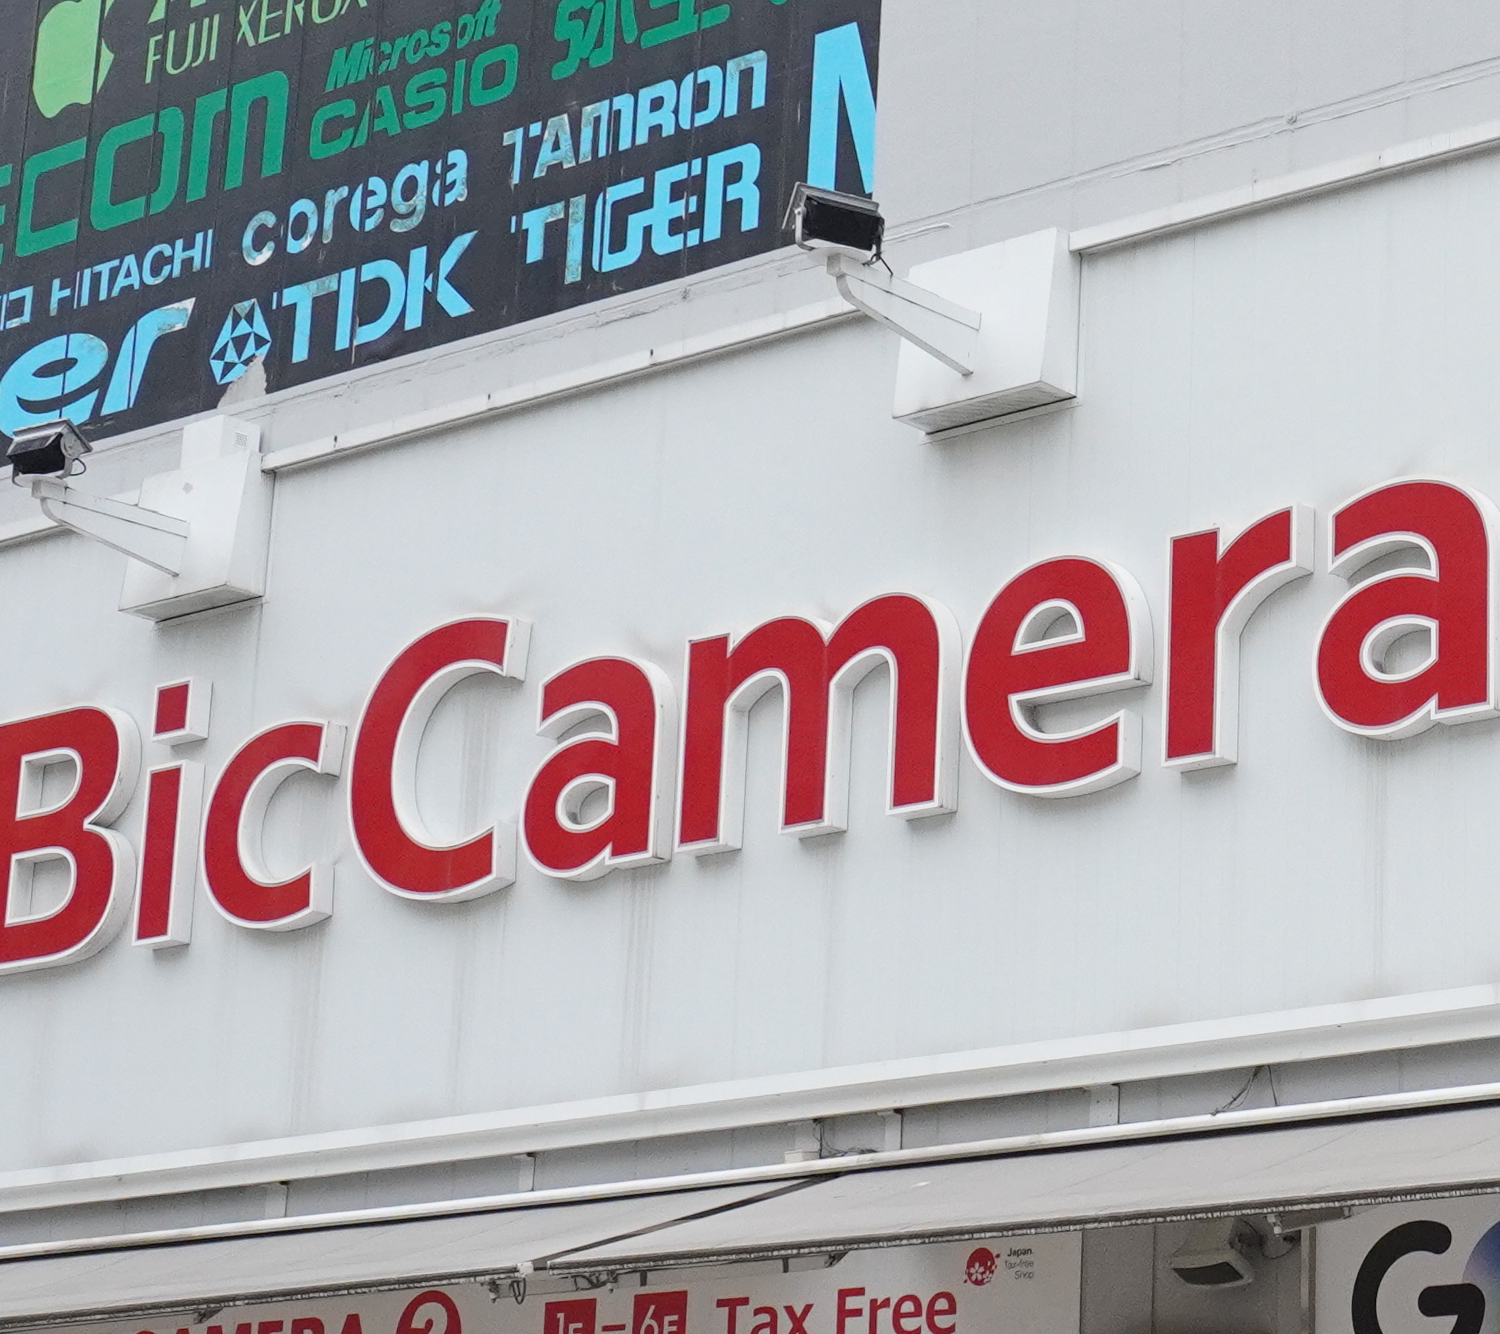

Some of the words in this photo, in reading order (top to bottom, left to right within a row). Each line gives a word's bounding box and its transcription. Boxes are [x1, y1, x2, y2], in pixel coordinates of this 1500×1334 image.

[146, 23, 221, 83] FUJI
[309, 43, 518, 160] CASIO
[49, 229, 212, 314] HITACHI
[503, 50, 768, 186] TAMRON
[271, 230, 479, 362] TDK
[510, 143, 761, 284] TIGER
